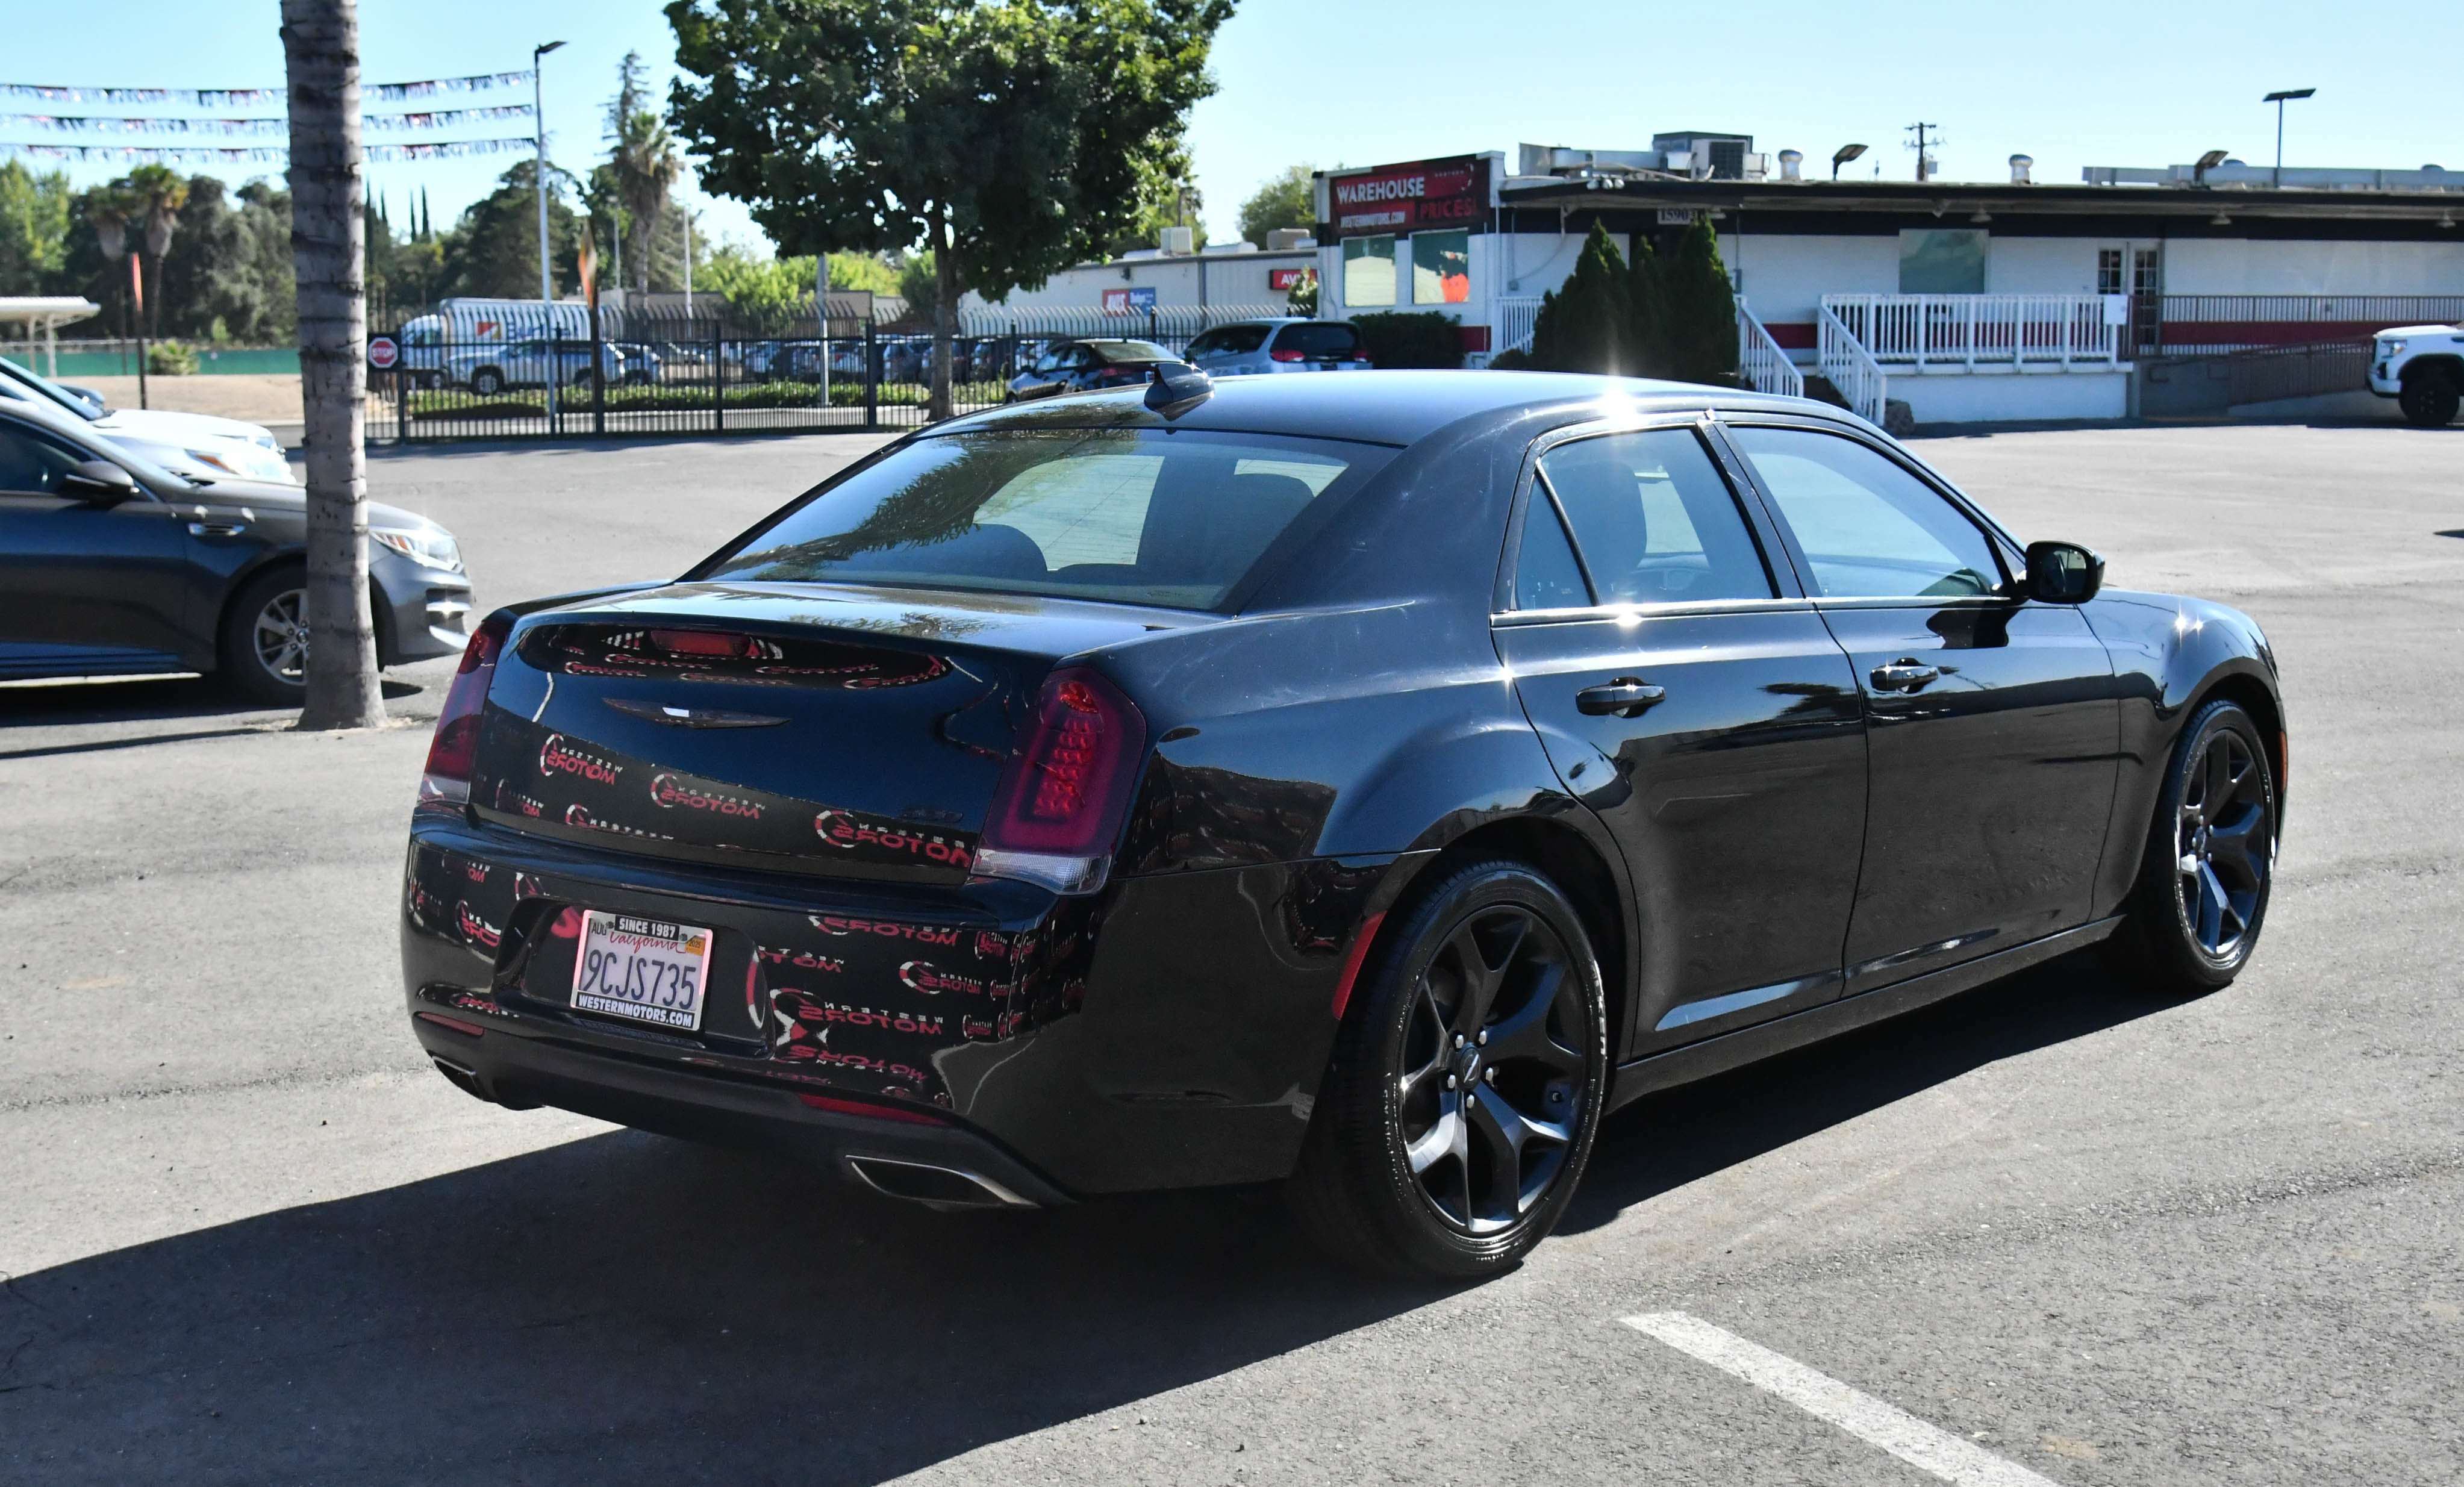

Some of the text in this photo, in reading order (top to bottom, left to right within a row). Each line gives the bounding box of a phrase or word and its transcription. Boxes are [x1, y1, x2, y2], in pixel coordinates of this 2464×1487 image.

[1336, 176, 1425, 205] WAREHOUSE
[372, 348, 395, 358] STOP
[591, 923, 607, 936] AUG
[619, 917, 676, 938] SINCE 1987
[583, 949, 696, 1009] 9CJS735
[578, 994, 693, 1027] WESTERNMOTORS.COM
